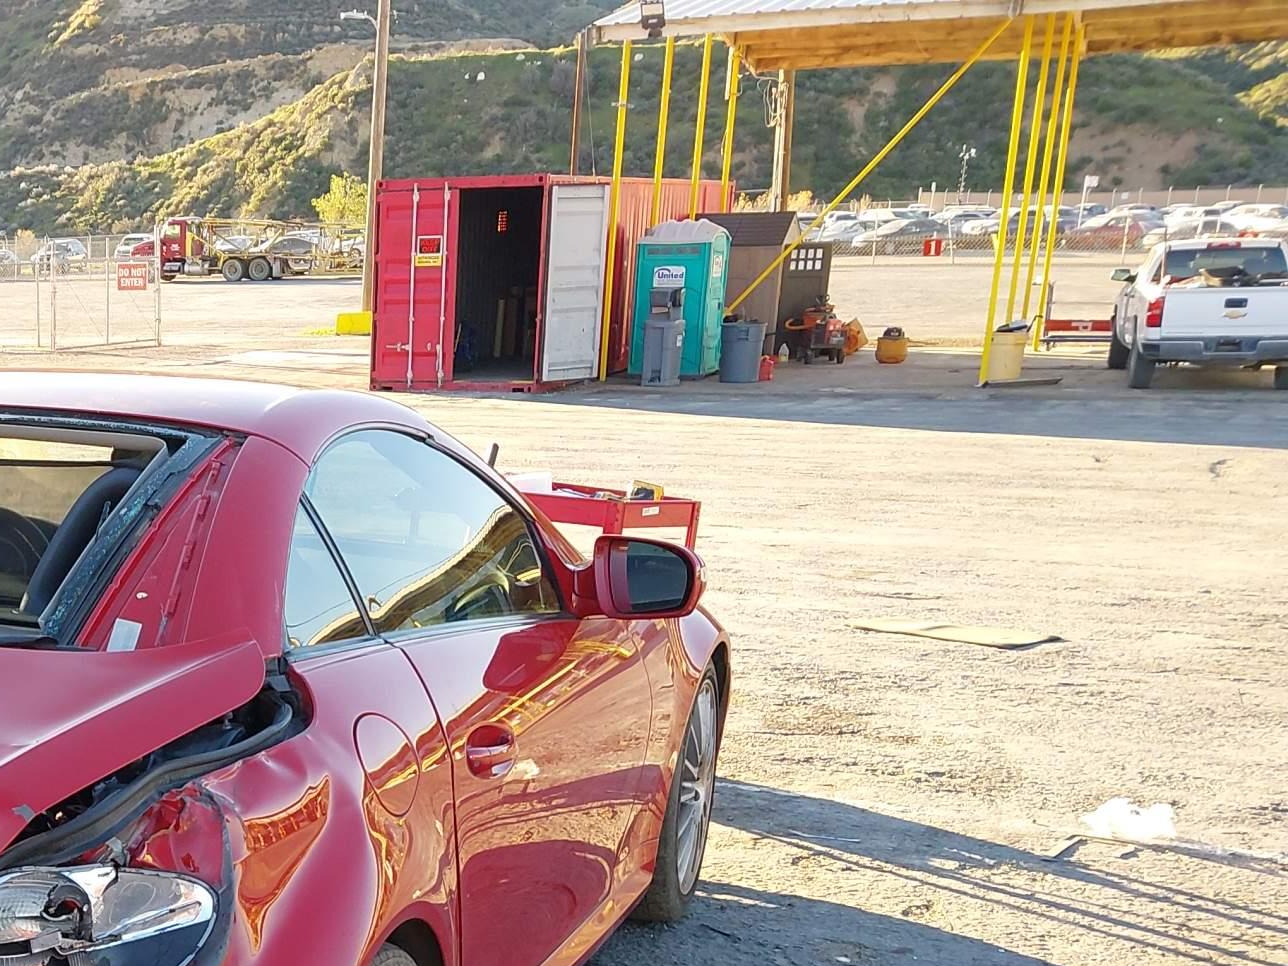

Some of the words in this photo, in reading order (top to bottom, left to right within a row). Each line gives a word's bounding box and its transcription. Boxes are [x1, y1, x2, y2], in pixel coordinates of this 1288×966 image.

[118, 268, 130, 277] DO
[131, 268, 147, 277] NOT
[657, 271, 685, 279] United
[120, 278, 145, 287] ENTER
